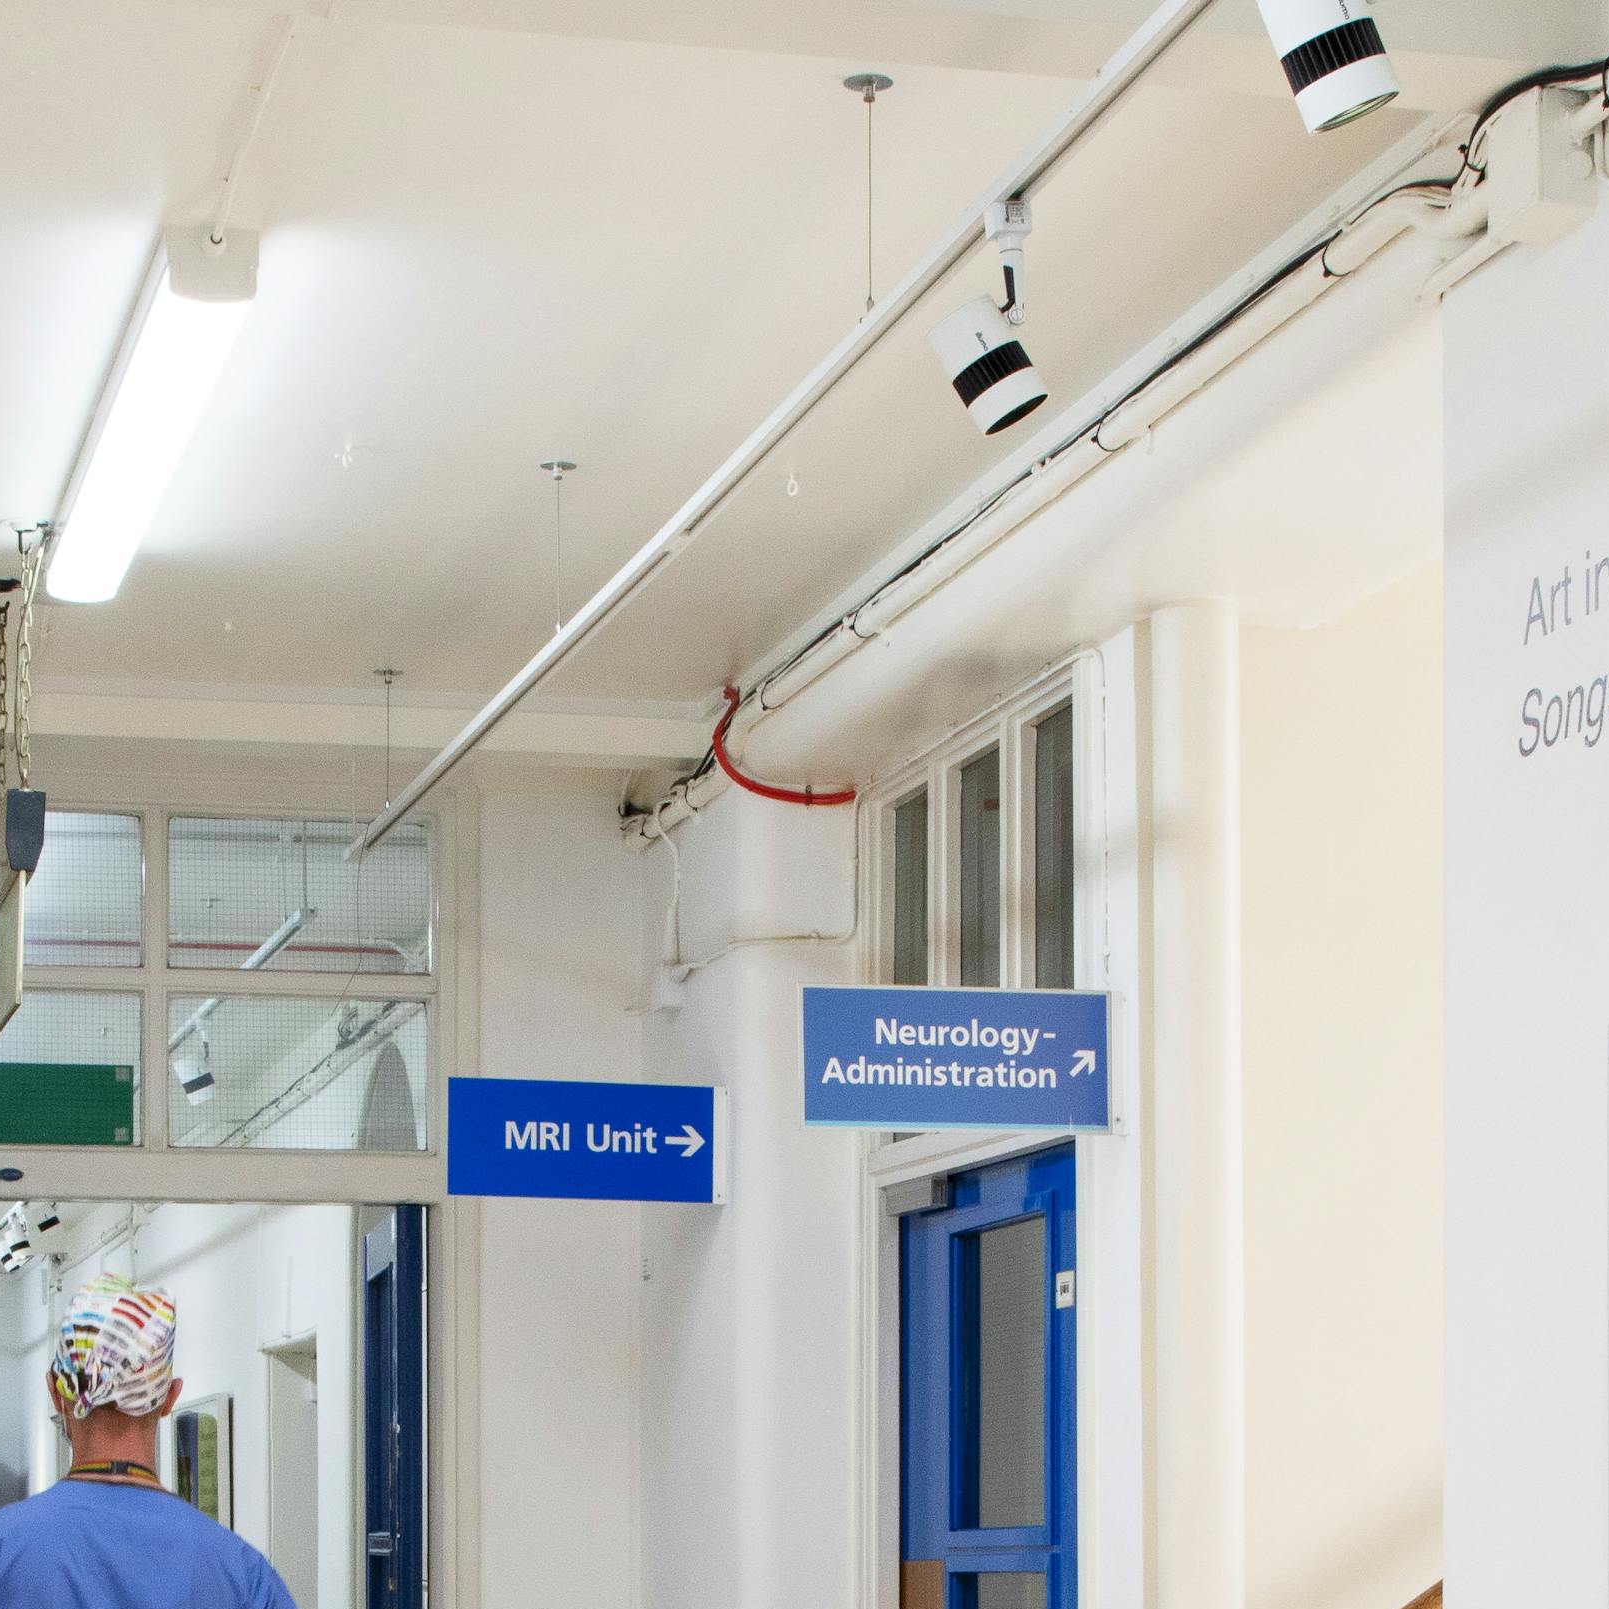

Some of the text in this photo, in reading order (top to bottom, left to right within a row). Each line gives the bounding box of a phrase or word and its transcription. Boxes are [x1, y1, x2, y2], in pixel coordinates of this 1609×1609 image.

[1523, 566, 1573, 645] Art
[875, 1018, 1056, 1055] Neurology-
[822, 1056, 1057, 1089] Administration
[505, 1121, 659, 1155] MRI Unit
